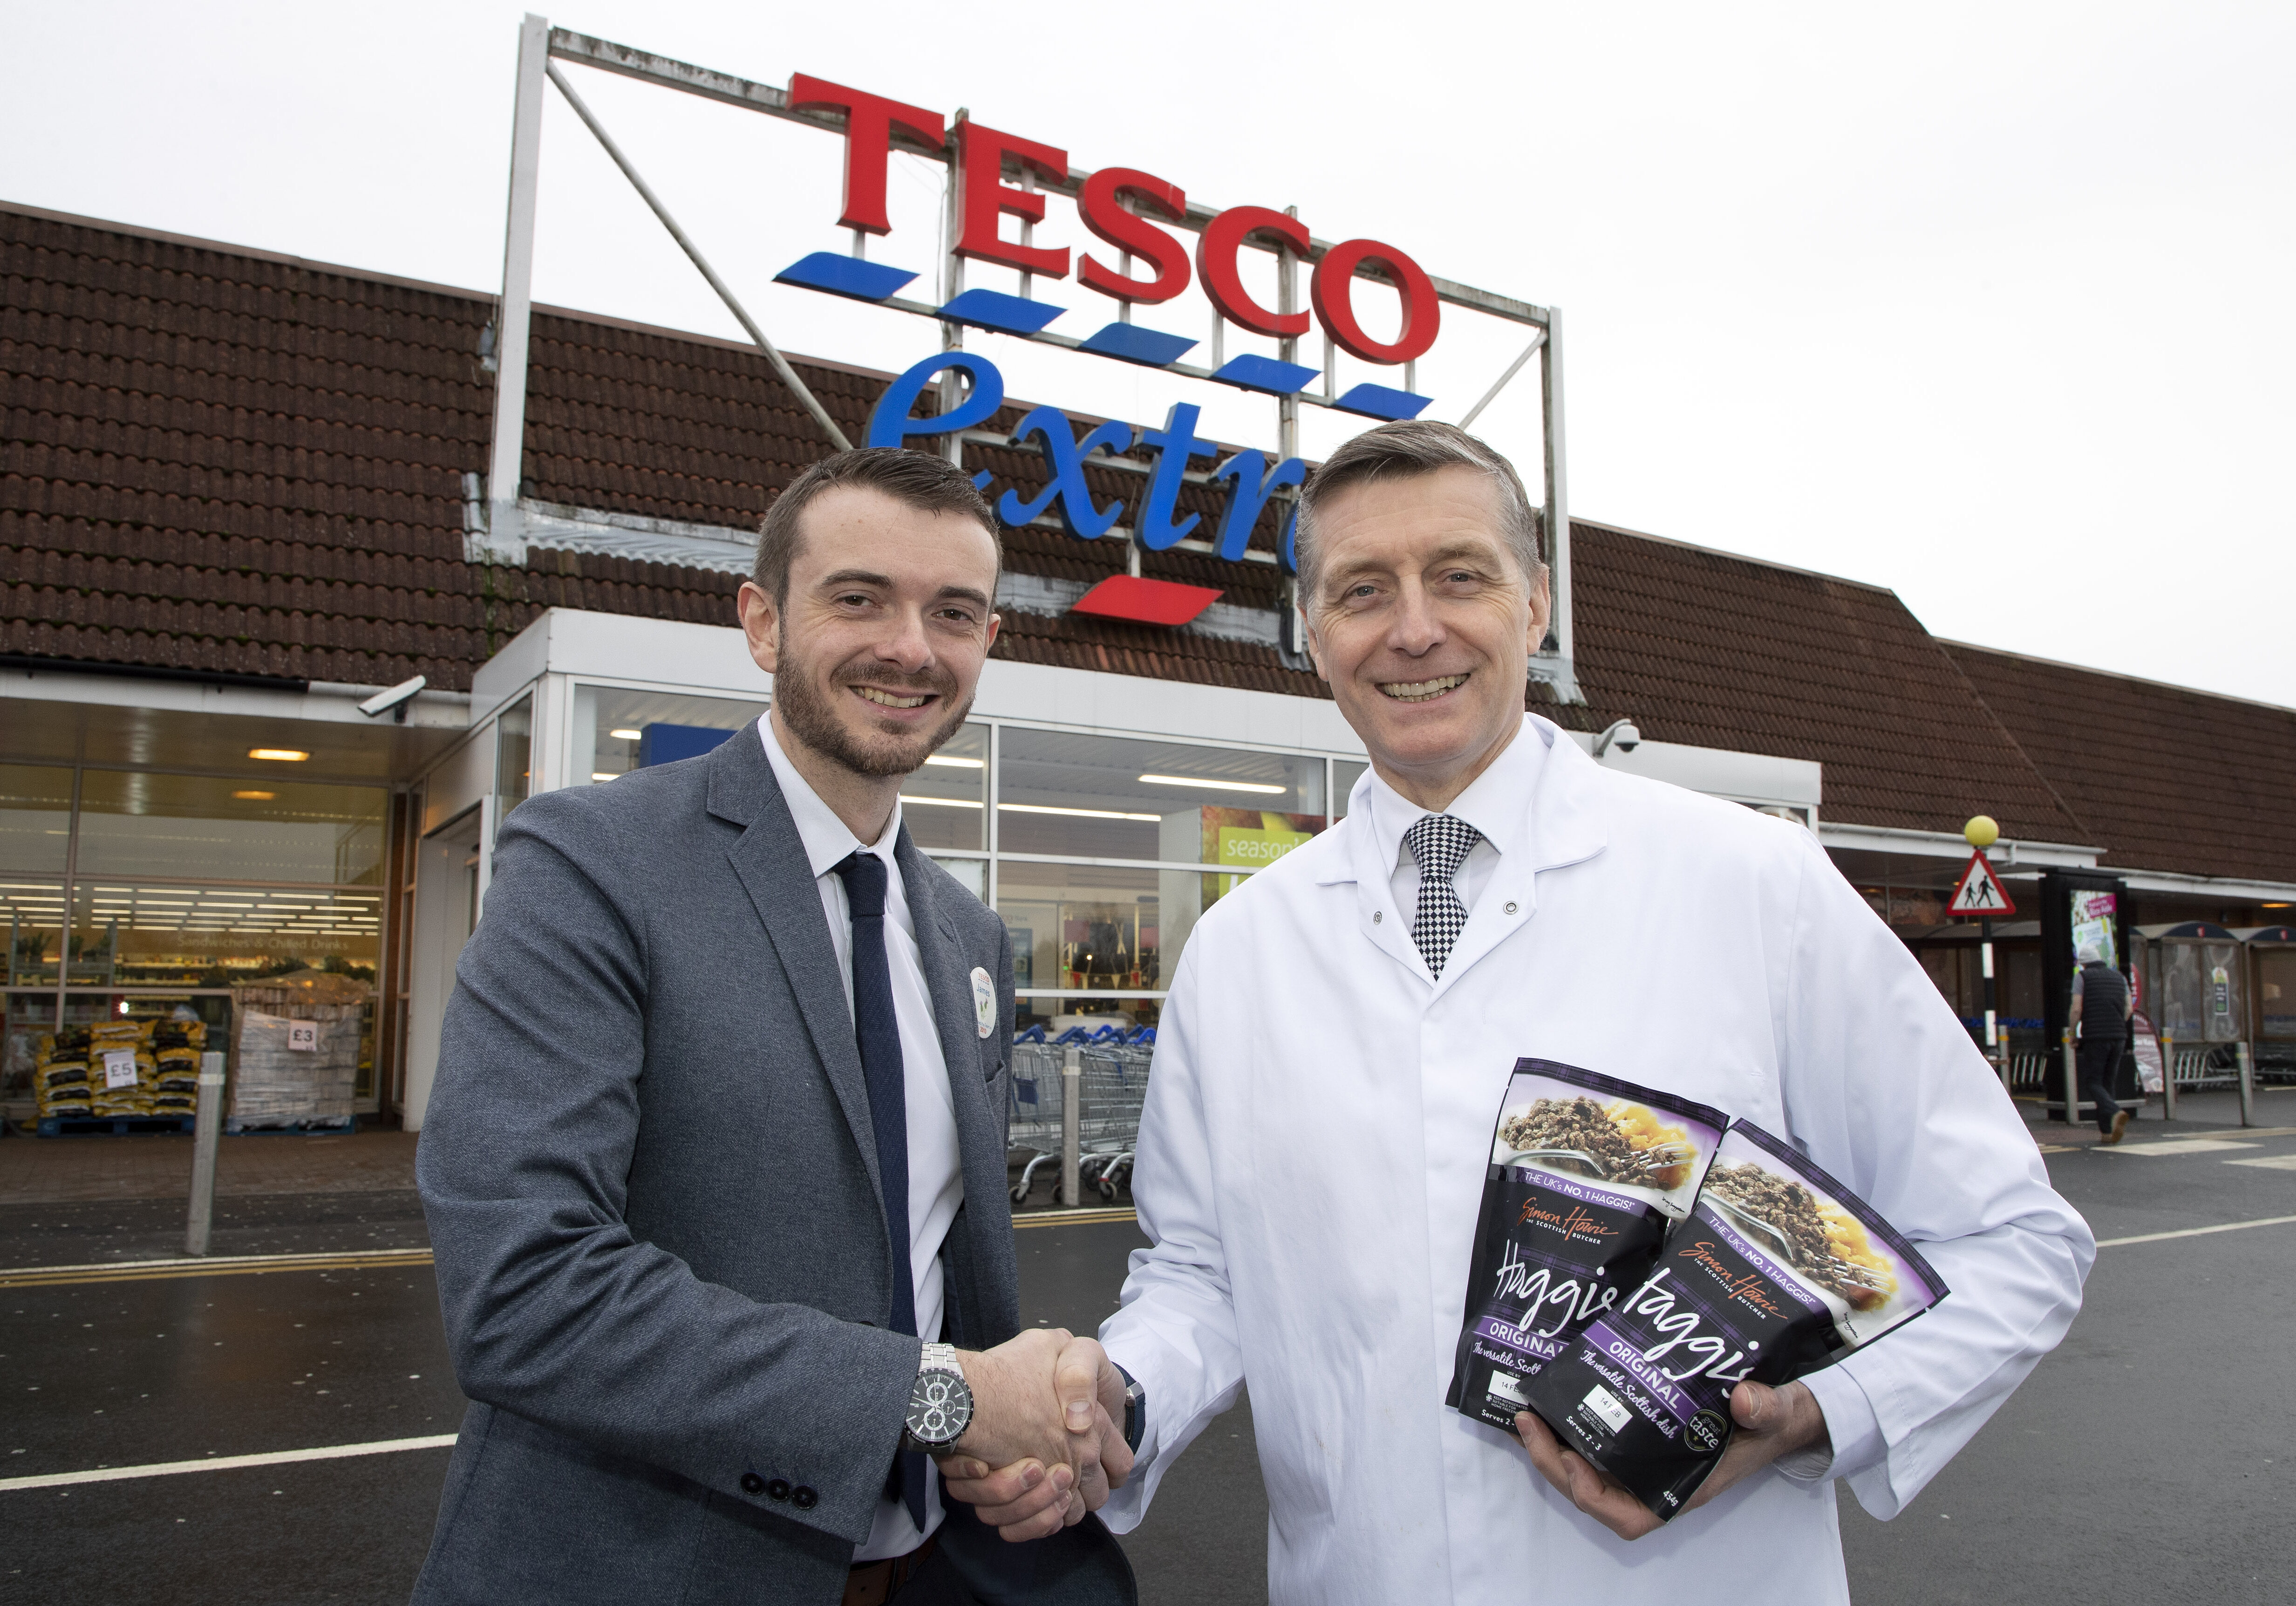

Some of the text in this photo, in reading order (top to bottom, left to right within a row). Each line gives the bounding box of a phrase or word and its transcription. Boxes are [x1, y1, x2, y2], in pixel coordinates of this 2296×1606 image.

[785, 71, 1441, 366] TESCO
[862, 349, 1298, 576] extr
[1226, 838, 1299, 860] season'
[978, 973, 989, 983] TESCO
[977, 984, 990, 997] James
[293, 1029, 313, 1042] £3
[110, 1063, 132, 1077] £5
[1526, 1171, 1543, 1183] THE
[1544, 1178, 1562, 1190] UK's
[1563, 1184, 1582, 1197] NO.
[1585, 1191, 1589, 1199] 1
[1517, 1197, 1619, 1241] Simon Howie
[1536, 1220, 1567, 1235] SCOTTISH
[1573, 1233, 1601, 1245] BUTCHER
[1709, 1216, 1729, 1236] THE
[1727, 1234, 1745, 1253] UK's
[1745, 1250, 1764, 1268] NO.
[1678, 1242, 1788, 1319] Simon Howie
[1694, 1257, 1766, 1319] THE SCOTTISH BUTCHER
[1473, 1341, 1542, 1375] The versatile Scott
[1609, 1341, 1681, 1409] ORIGINAL
[1509, 1384, 1520, 1394] FE
[1580, 1350, 1678, 1439] The versatile Scottish dish
[1492, 1399, 1508, 1408] SUITABLE
[1607, 1404, 1621, 1418] FEB
[1481, 1409, 1504, 1423] Serves
[1566, 1416, 1586, 1436] Serves
[1580, 1413, 1589, 1423] HOME
[1583, 1410, 1597, 1425] SUITABLE
[1702, 1417, 1721, 1435] great
[1690, 1416, 1718, 1448] taste
[1663, 1490, 1678, 1507] 454g
